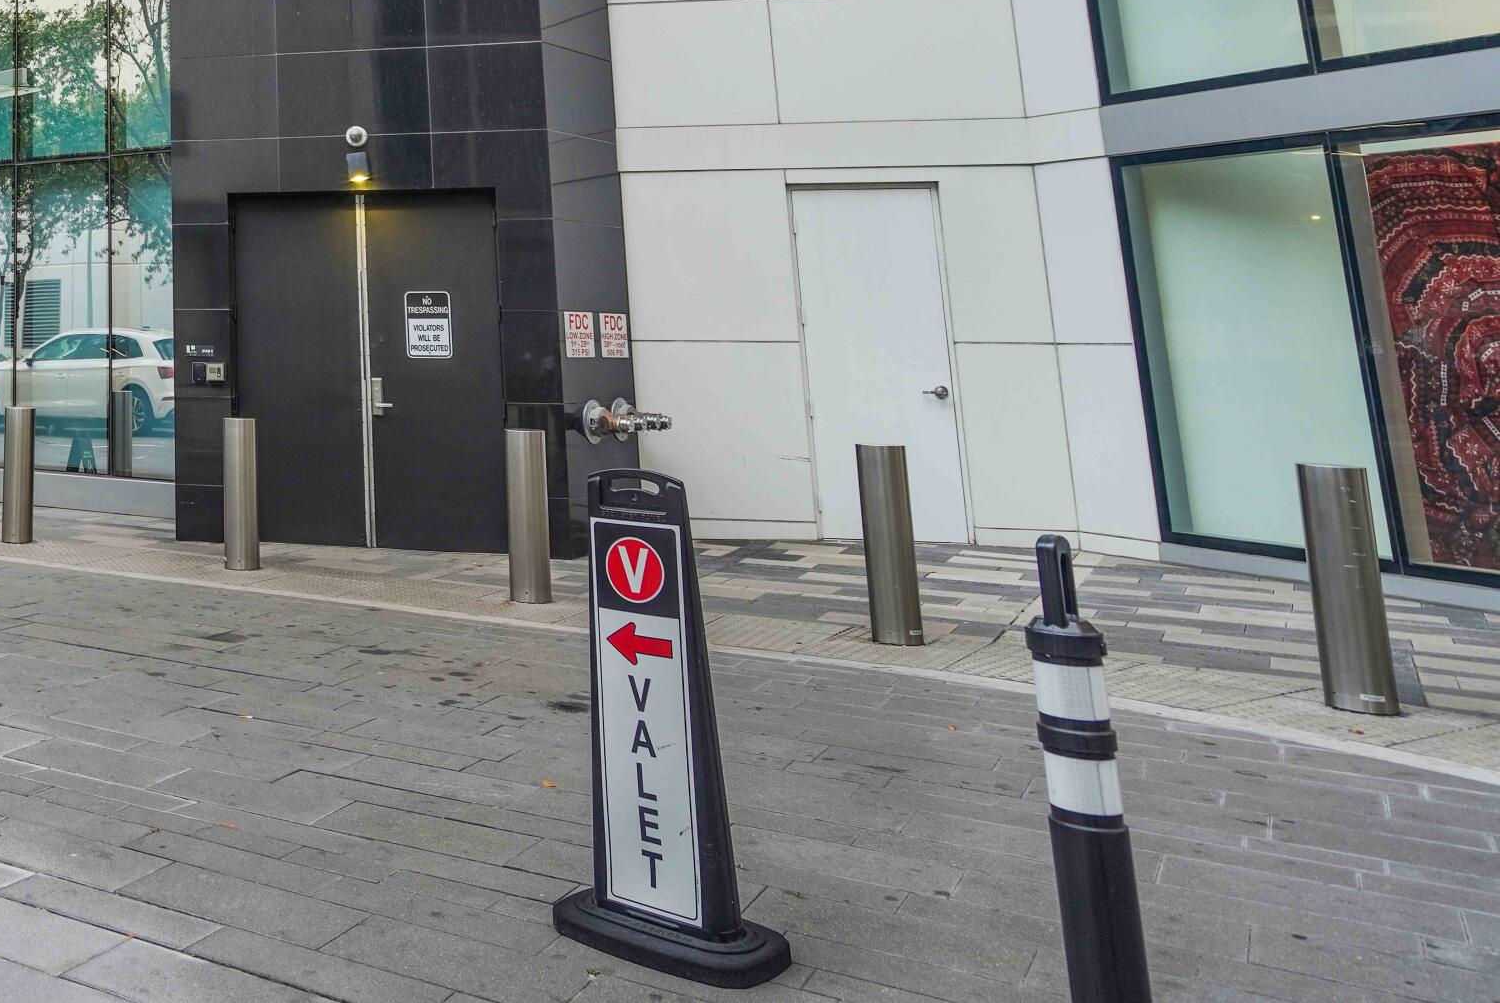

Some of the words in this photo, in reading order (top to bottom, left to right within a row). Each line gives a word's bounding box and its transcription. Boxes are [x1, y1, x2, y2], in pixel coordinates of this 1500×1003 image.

[422, 297, 432, 305] NO
[408, 306, 449, 314] TRESPASSING
[568, 313, 589, 329] FDC
[603, 315, 623, 331] FDC
[417, 334, 431, 342] WILL
[432, 334, 441, 342] BE
[566, 332, 578, 340] LOW
[579, 332, 593, 340] ZONE
[614, 333, 628, 341] ZONE
[410, 344, 449, 352] PROSECUTED
[616, 349, 625, 357] PSI
[617, 545, 649, 594] V
[627, 674, 664, 890] VALET
